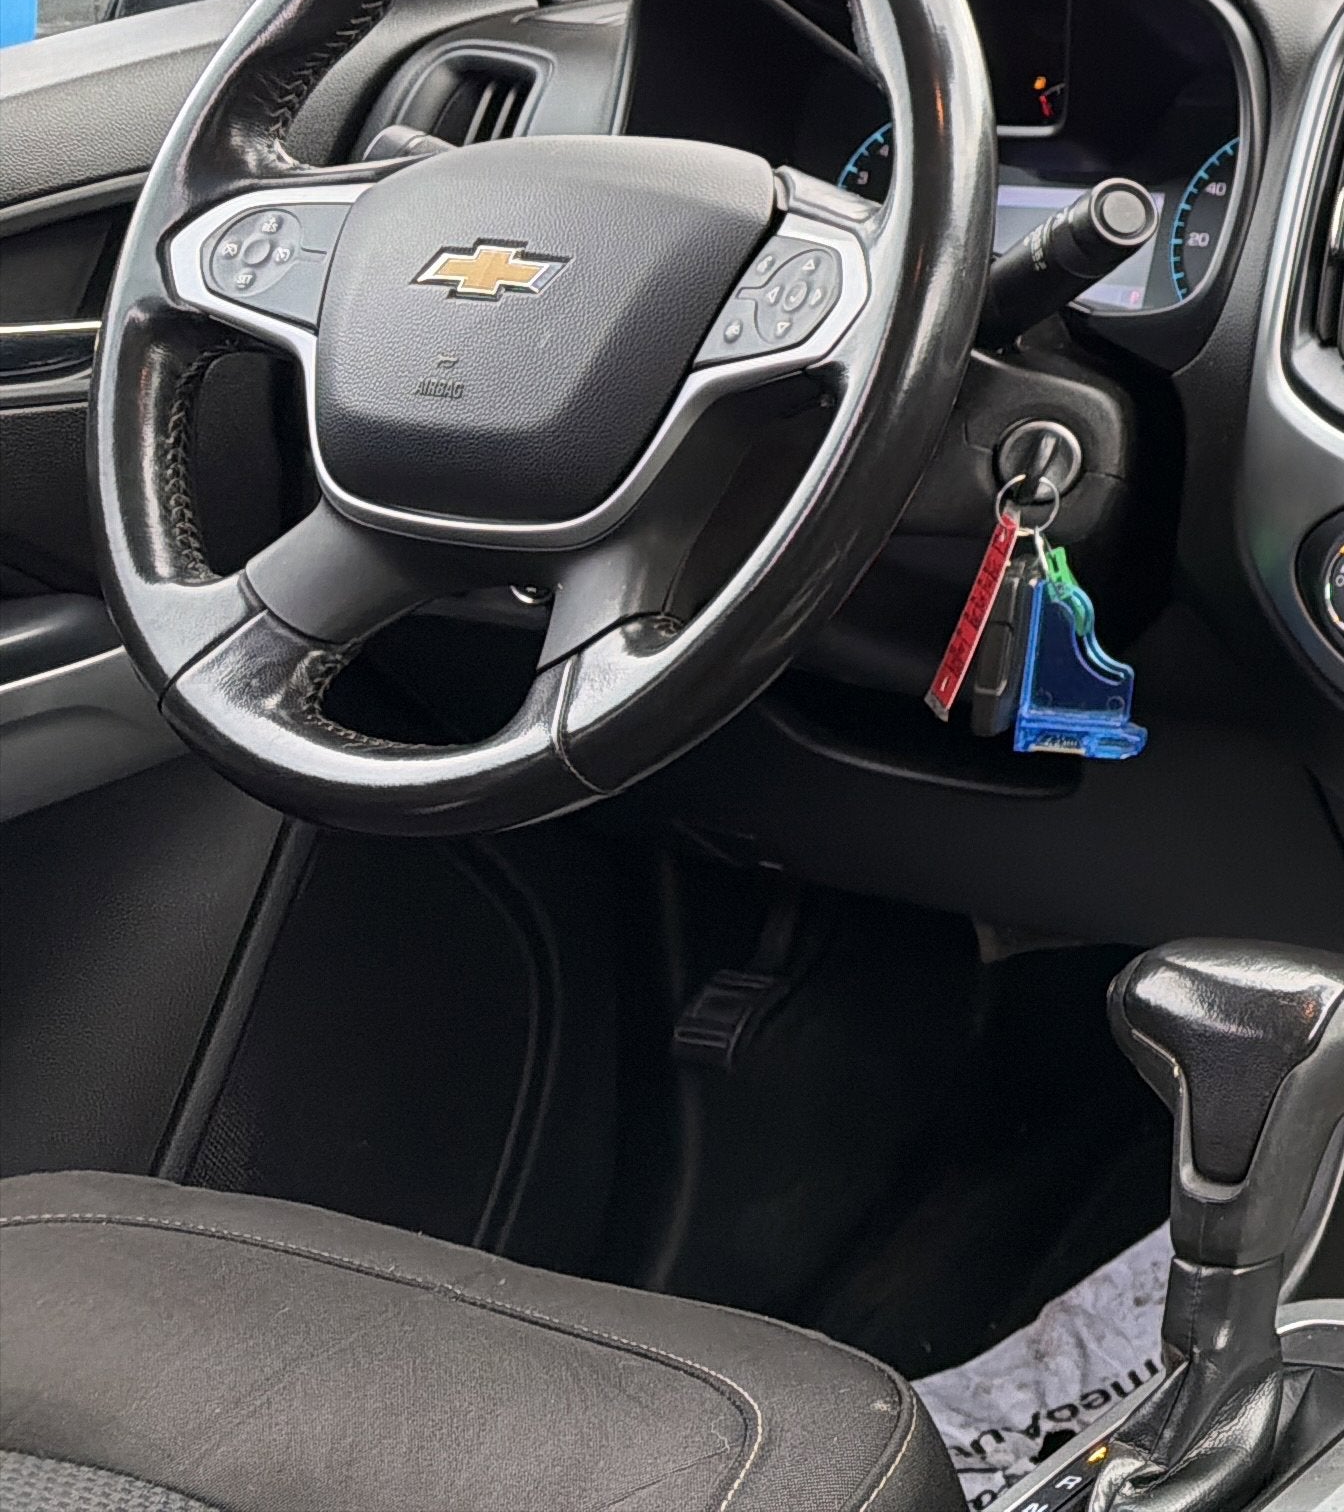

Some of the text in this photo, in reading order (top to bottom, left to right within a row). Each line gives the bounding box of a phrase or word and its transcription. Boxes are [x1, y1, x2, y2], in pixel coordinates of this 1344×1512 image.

[1205, 182, 1227, 196] 40
[1188, 232, 1210, 247] 20
[411, 377, 465, 399] AIRBAG
[1055, 1475, 1083, 1490] R
